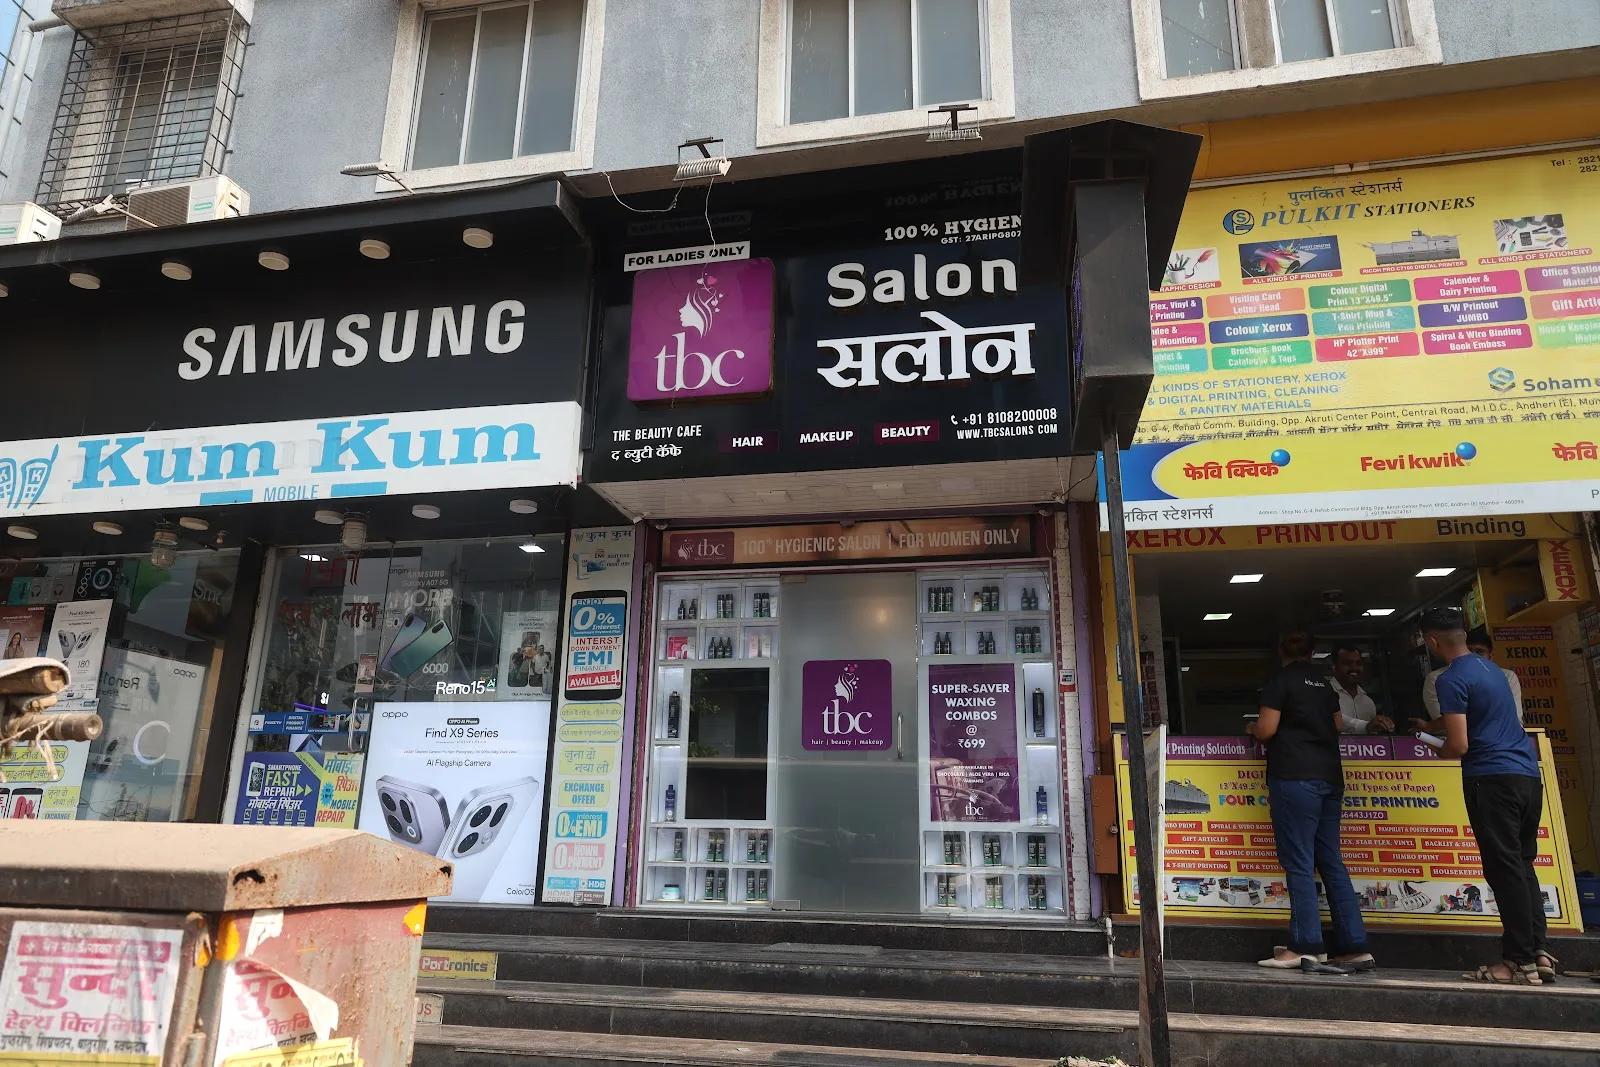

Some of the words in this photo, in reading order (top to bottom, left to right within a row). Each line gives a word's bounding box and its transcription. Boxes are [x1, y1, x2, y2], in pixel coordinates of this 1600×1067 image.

[1287, 185, 1345, 206] पुलकित
[1261, 202, 1361, 227] PULKIT
[1364, 196, 1476, 218] STATIONERS
[944, 214, 1022, 235] HYGIEN
[941, 236, 962, 245] GST:
[965, 230, 1022, 242] 27ARIPG807
[628, 254, 654, 267] FOR
[658, 250, 705, 264] LADIES
[708, 246, 745, 259] ONLY
[1481, 257, 1497, 265] ALL
[1498, 255, 1523, 263] KINDS
[1539, 248, 1590, 260] STATIONERY
[827, 253, 1018, 308] Salon
[1440, 288, 1463, 297] Dairy
[1464, 285, 1496, 295] Printing
[1443, 303, 1461, 313] B/W
[1463, 301, 1499, 311] Printout
[1456, 313, 1489, 323] JUMBO
[1225, 325, 1259, 337] Colour
[1262, 322, 1292, 333] Xerox
[178, 299, 526, 380] SAMSUNG
[1160, 336, 1197, 345] Mounting
[1450, 342, 1471, 351] Book
[1473, 340, 1506, 349] Emboss
[816, 310, 1036, 388] सलोन
[654, 331, 745, 393] tbc
[1163, 382, 1199, 393] KINDS
[1203, 380, 1219, 390] OF
[1222, 374, 1301, 389] STATIONERY,
[1304, 371, 1347, 382] XEROX
[1523, 377, 1592, 392] Soham
[1147, 397, 1155, 406] &
[1159, 394, 1205, 405] DIGITAL
[1208, 389, 1271, 402] PRINTING,
[1274, 384, 1339, 398] CLEANING
[1179, 408, 1187, 416] &
[1191, 403, 1237, 415] PANTRY
[1241, 398, 1312, 412] MATERIALS
[962, 413, 983, 426] +91
[987, 408, 1058, 424] 8108200008
[1203, 420, 1236, 430] Comm.
[1238, 417, 1279, 429] Building,
[1281, 416, 1303, 427] Opp.
[1305, 414, 1334, 424] Akruti
[1336, 412, 1368, 421] Center
[1371, 410, 1400, 420] Point,
[1401, 408, 1437, 417] Central
[1440, 406, 1469, 416] Road,
[1516, 399, 1557, 410] Andheri
[613, 429, 631, 442] THE
[635, 426, 673, 441] BEAUTY
[677, 424, 702, 438] CAFE
[799, 430, 853, 443] MAKEUP
[881, 425, 931, 438] BEAUTY
[732, 436, 763, 447] HAIR
[73, 435, 282, 490] Kum
[312, 418, 541, 474] Kum
[611, 450, 620, 462] द
[1552, 441, 1598, 462] फेवि
[1183, 461, 1222, 480] फेवि
[1226, 459, 1279, 479] क्विक
[263, 484, 319, 502] MOBILE
[1126, 526, 1227, 549] XEROX
[1256, 521, 1397, 545] PRINTOUT
[1436, 516, 1526, 538] Binding
[698, 538, 725, 556] tbc
[776, 536, 835, 554] HYGIENIC
[838, 534, 881, 551] SALON
[900, 533, 925, 549] FOR
[928, 531, 981, 548] WOMEN
[984, 528, 1020, 545] ONLY
[1548, 540, 1580, 600] XEROX
[576, 636, 620, 646] INTERST
[573, 651, 613, 666] EMI
[1505, 646, 1548, 659] XEROX
[422, 662, 449, 675] 6000
[436, 680, 486, 696] Reno15
[931, 683, 1010, 694] SUPER-SAVER
[945, 697, 996, 707] WAXING
[382, 711, 408, 719] oppo
[822, 699, 873, 735] tbc
[945, 711, 998, 721] COMBOS
[425, 727, 447, 738] Find
[449, 727, 464, 738] X9
[467, 727, 499, 738] Series
[966, 724, 978, 736] @
[831, 738, 852, 746] beauty
[860, 738, 884, 747] makeup
[958, 738, 986, 749] ₹699
[1172, 743, 1205, 757] Printing
[1206, 743, 1246, 755] Solutions
[267, 764, 302, 772] SMARTPHONE
[435, 758, 463, 769] Flagship
[464, 759, 491, 767] Camera
[575, 763, 594, 773] नया
[265, 771, 300, 787] FAST
[264, 786, 295, 797] REPAIR
[564, 782, 605, 793] EXCHANGE
[330, 799, 357, 810] MOBILE
[572, 795, 596, 805] OFFER
[1218, 794, 1256, 806] FOUR
[965, 802, 984, 816] tbc
[316, 810, 345, 823] REPAIR
[576, 813, 603, 821] interest
[575, 820, 603, 838] EMI
[588, 880, 606, 888] HDB
[422, 957, 488, 972] Portronics
